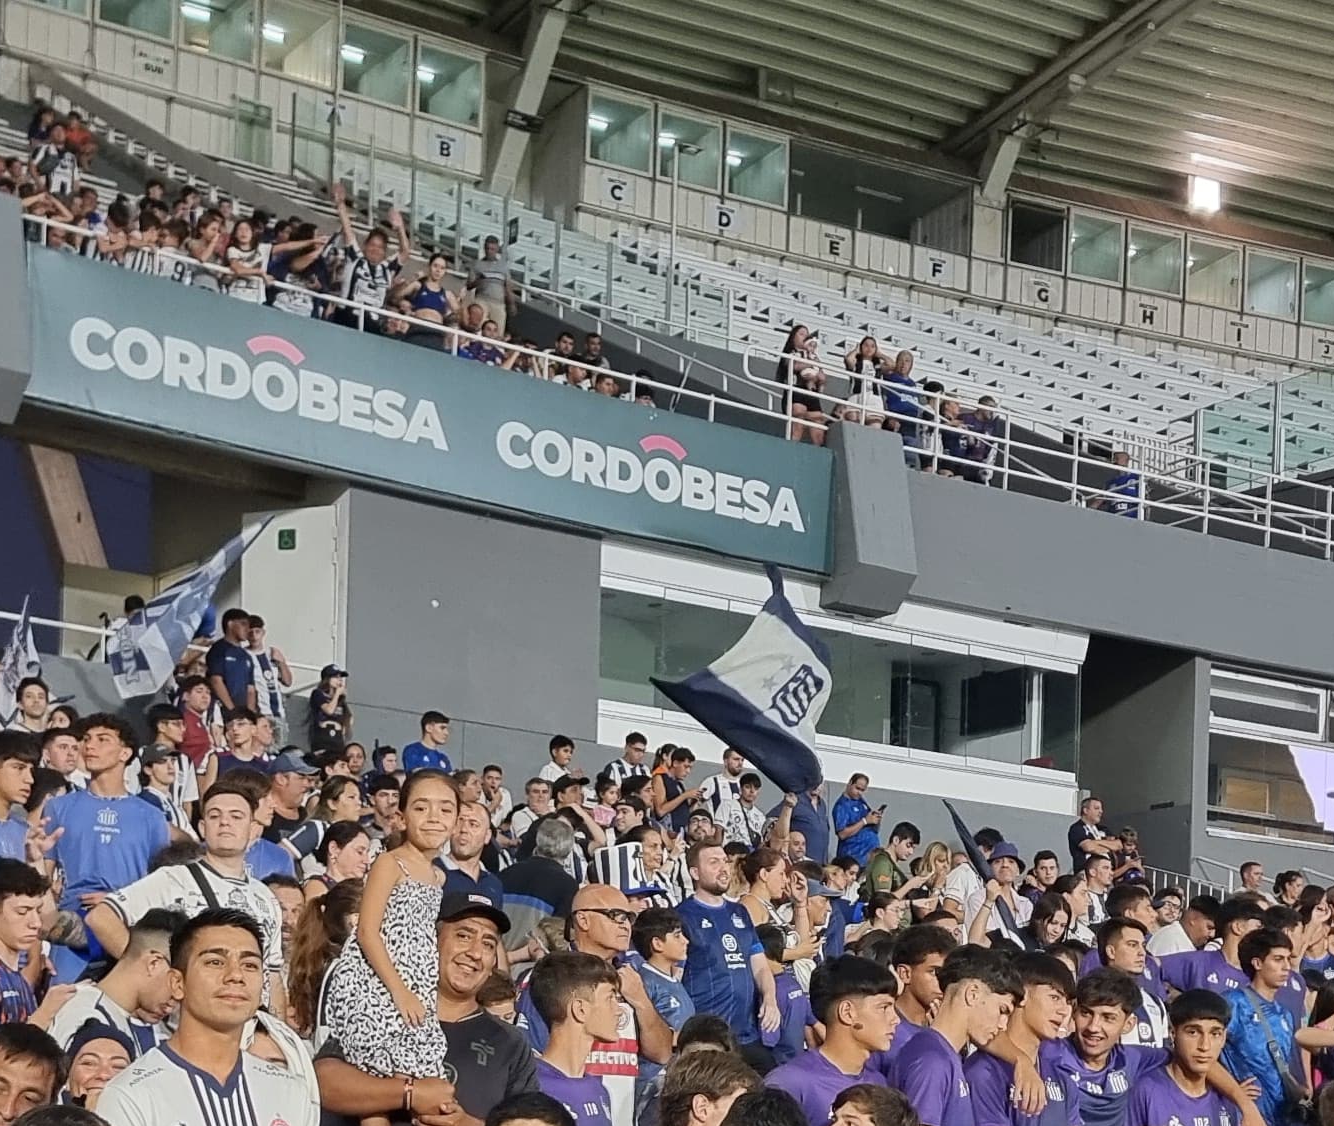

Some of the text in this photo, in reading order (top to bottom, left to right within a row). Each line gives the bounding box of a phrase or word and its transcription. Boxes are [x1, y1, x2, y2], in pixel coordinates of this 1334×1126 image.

[440, 140, 451, 157] B
[610, 184, 623, 201] C
[718, 211, 731, 228] D
[829, 240, 840, 256] E
[932, 262, 942, 278] F
[1037, 288, 1049, 303] G
[1143, 309, 1154, 325] H
[1324, 344, 1330, 354] J
[69, 316, 449, 452] CORDOBESA
[496, 420, 806, 534] CORDOBESA
